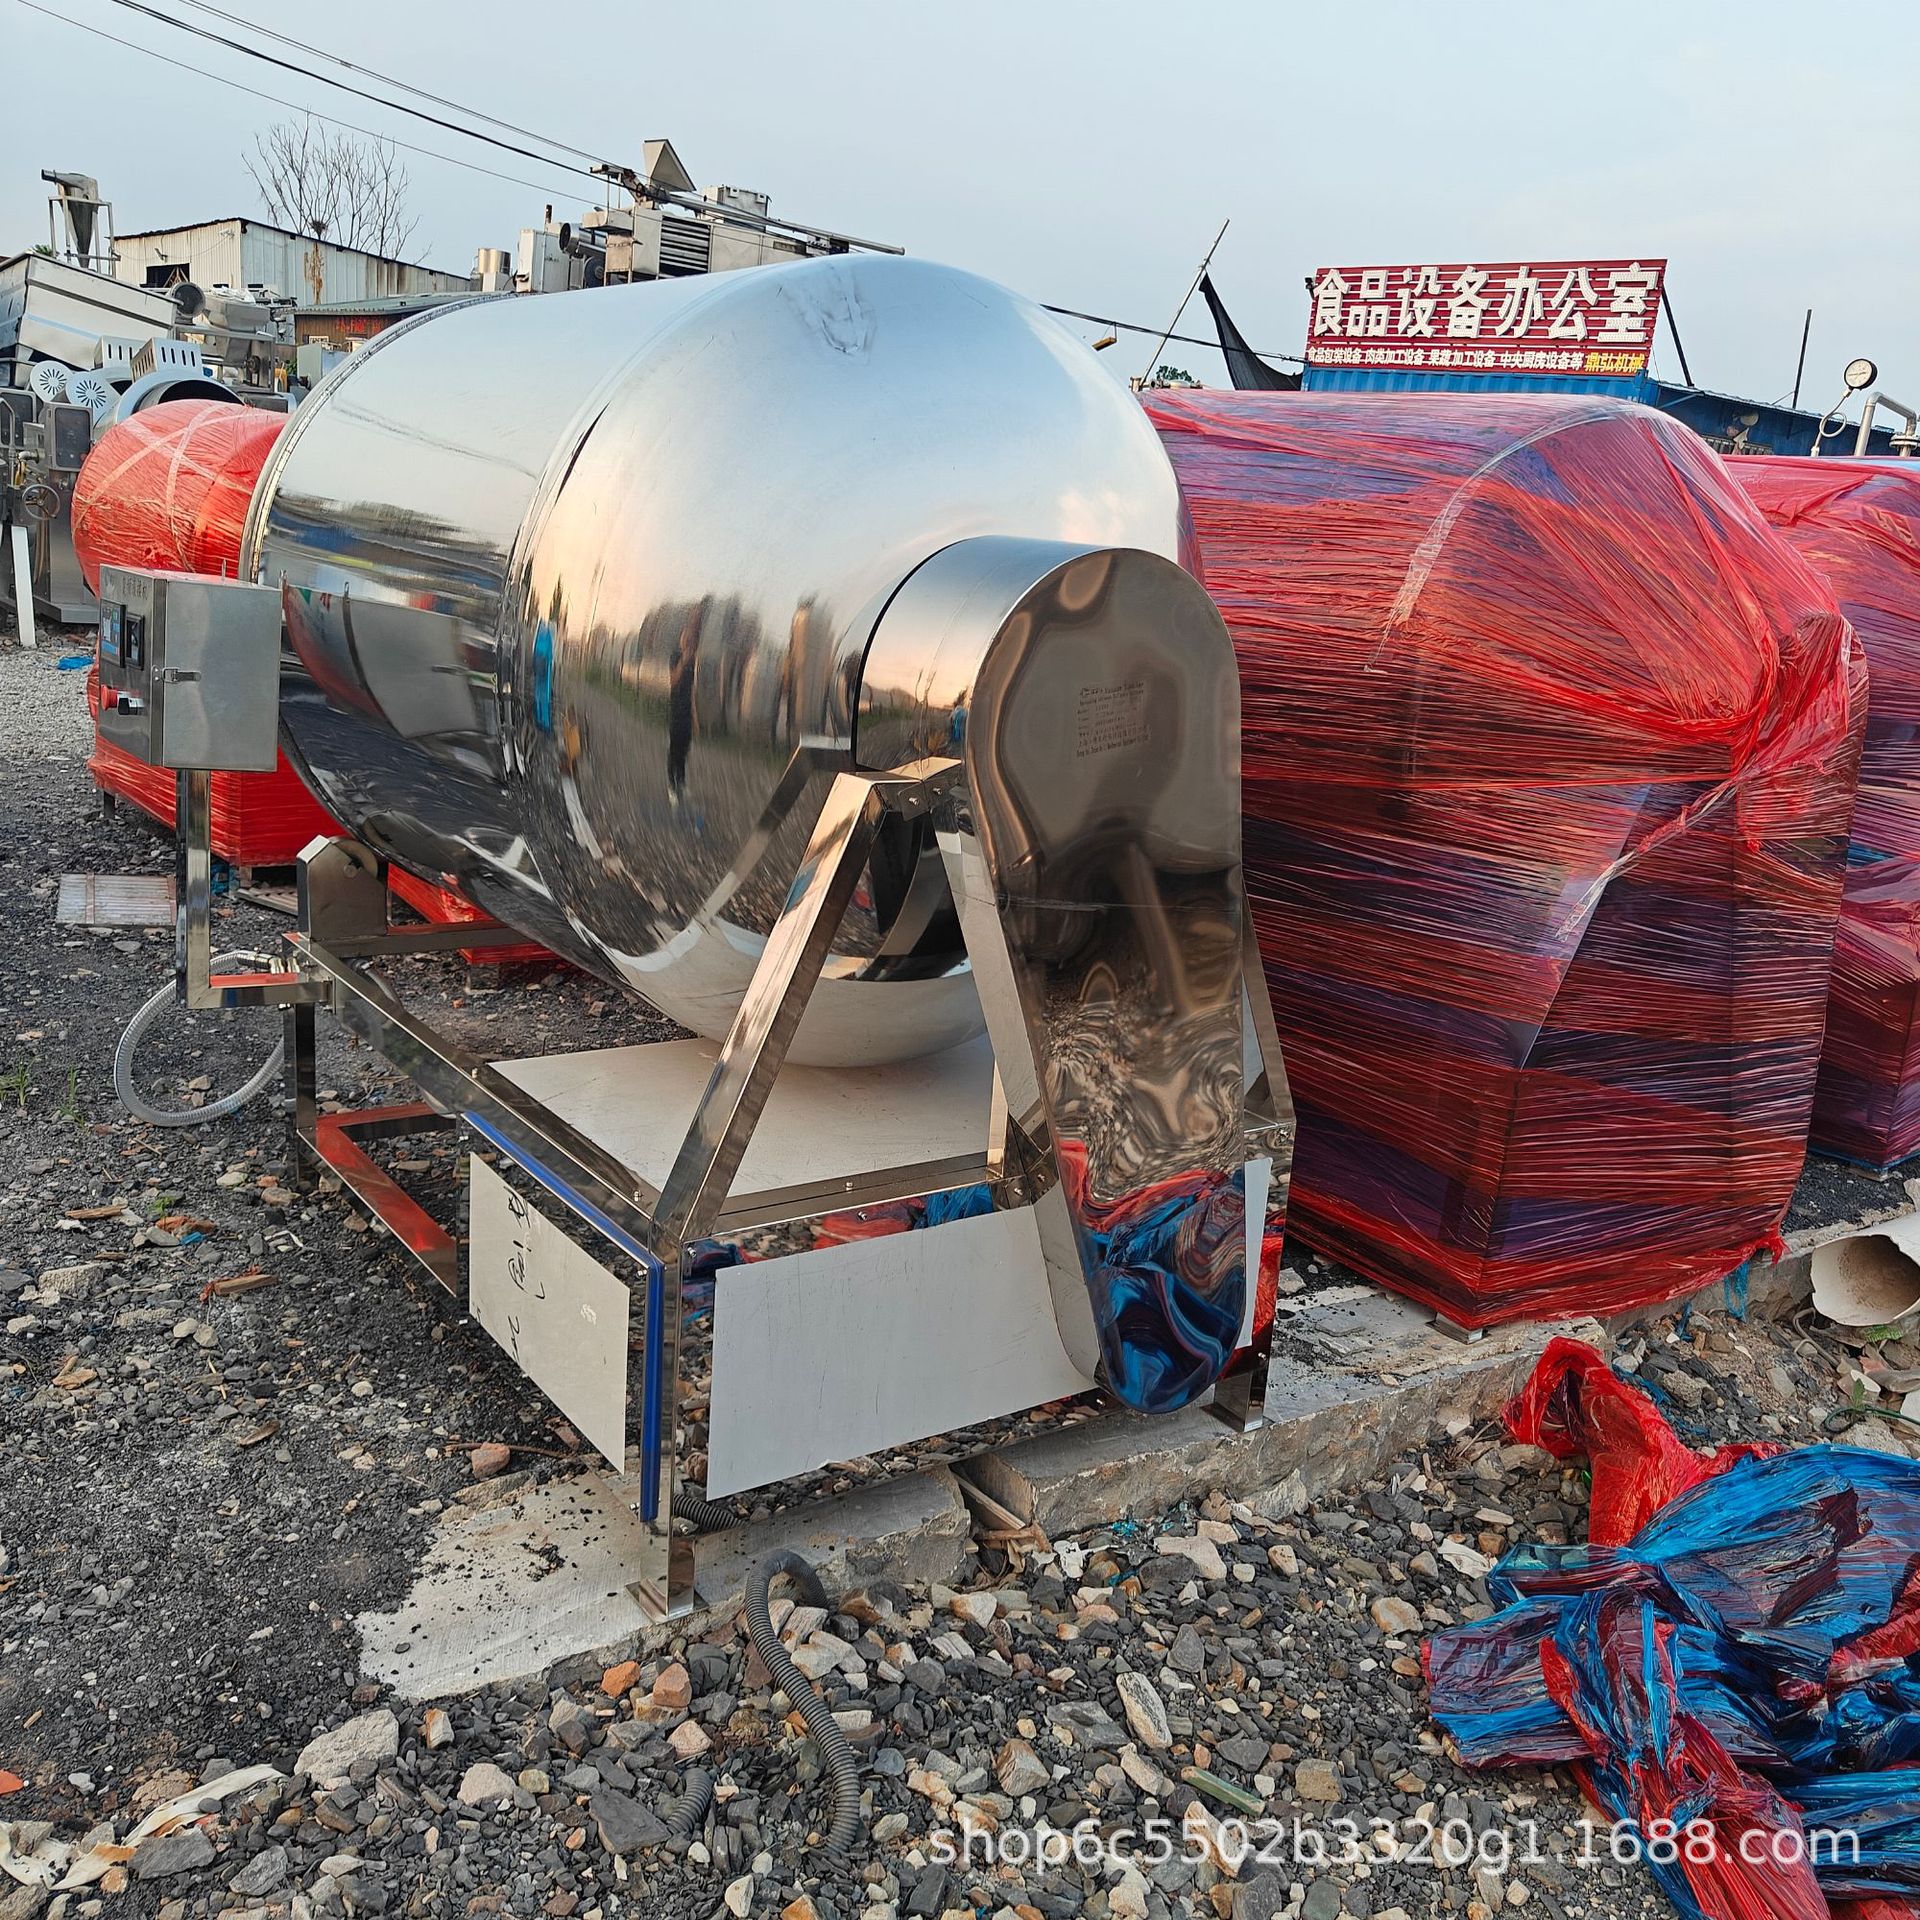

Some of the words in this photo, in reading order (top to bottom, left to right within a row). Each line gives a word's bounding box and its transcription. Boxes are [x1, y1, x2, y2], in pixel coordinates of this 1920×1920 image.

[1313, 262, 1659, 343] 食品设备办公室
[1307, 346, 1362, 364] 食品包装设备
[1364, 347, 1424, 366] 肉类加工设备
[1428, 348, 1496, 368] 果蔬加工设备
